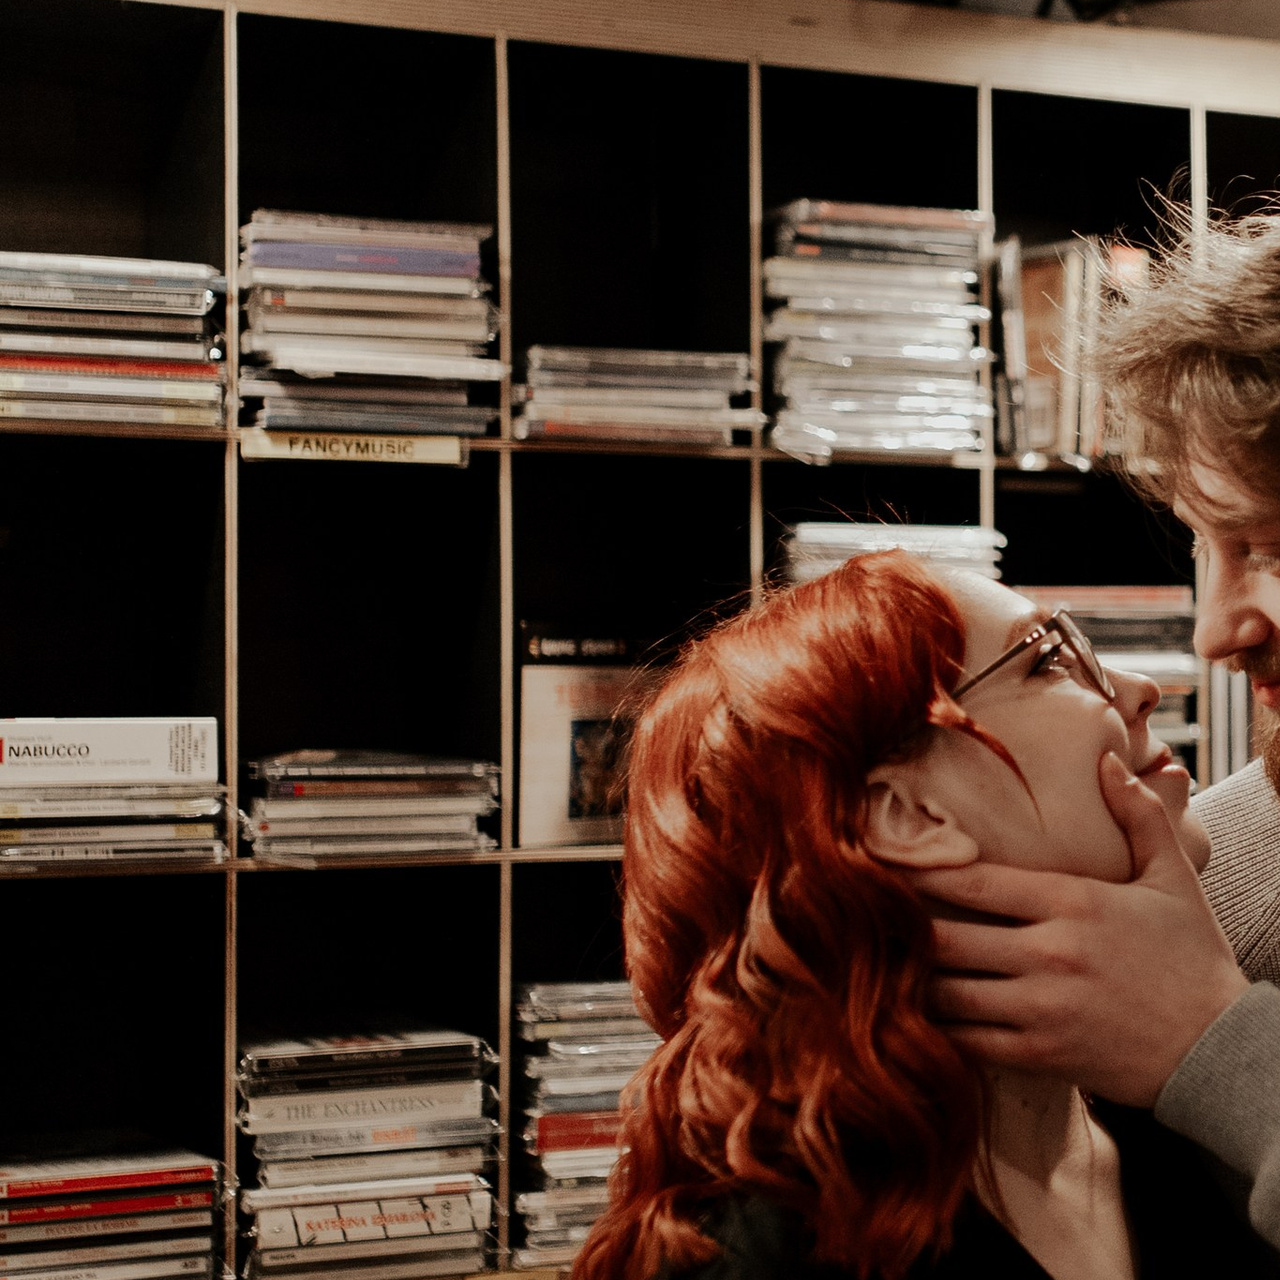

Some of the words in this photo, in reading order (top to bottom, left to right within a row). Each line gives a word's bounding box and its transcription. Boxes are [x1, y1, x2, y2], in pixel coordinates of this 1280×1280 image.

[288, 436, 416, 455] FANCYMUSIC
[8, 743, 90, 759] NABUCCO
[284, 1104, 318, 1121] THE
